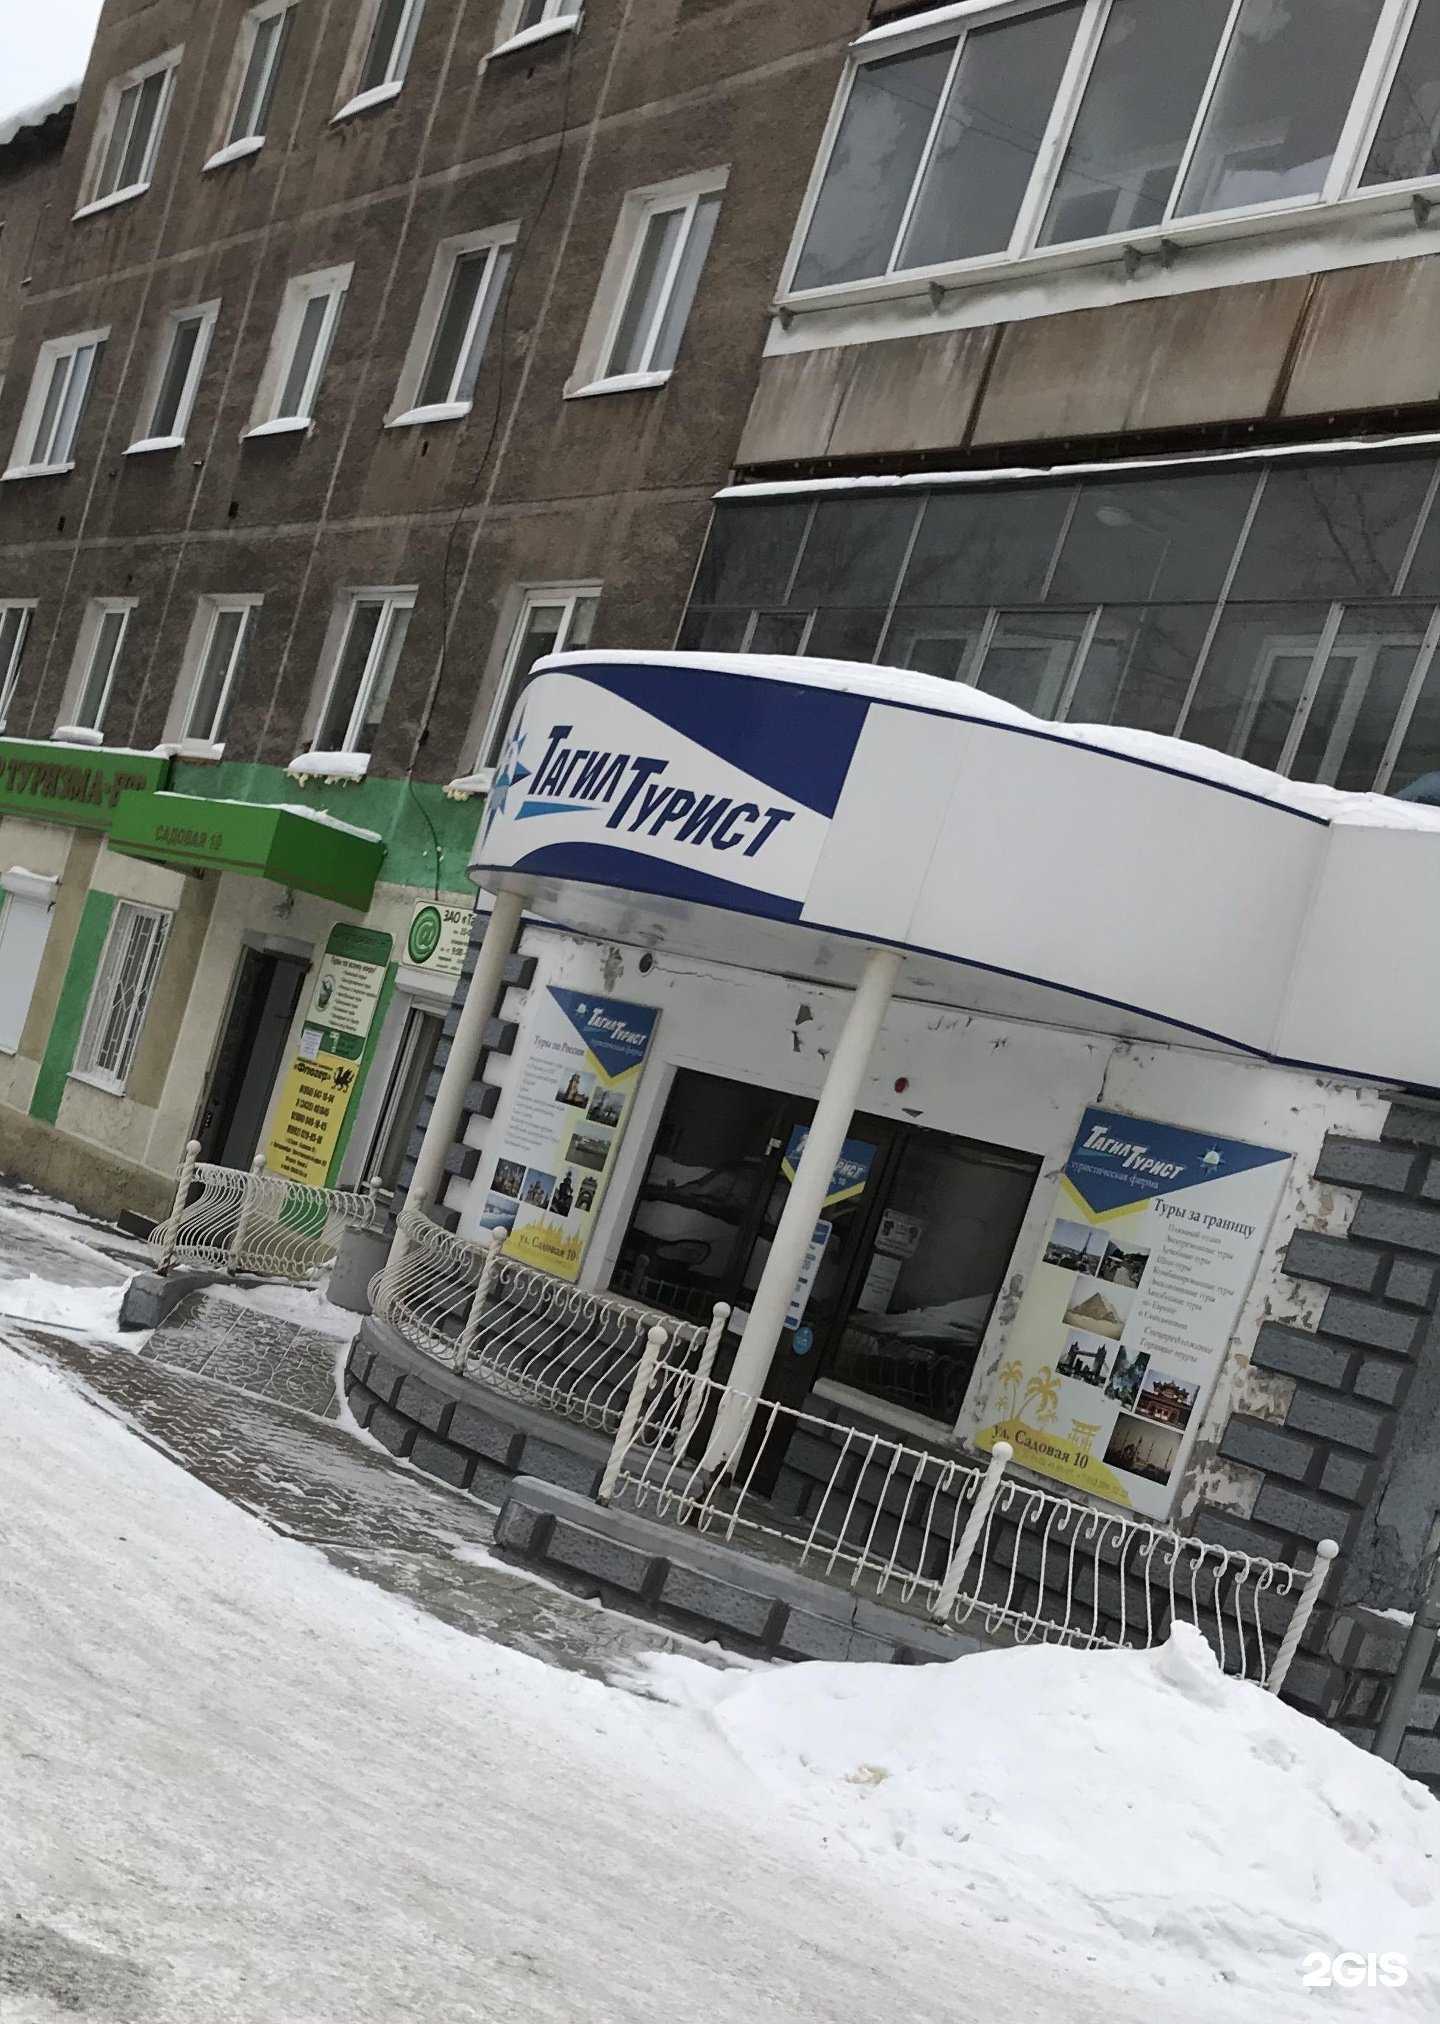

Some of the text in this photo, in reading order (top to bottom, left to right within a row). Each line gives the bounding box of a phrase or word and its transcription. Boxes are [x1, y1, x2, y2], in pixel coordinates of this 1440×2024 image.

[443, 909, 461, 924] ЗАО
[1154, 1198, 1256, 1240] Туры за границу
[1015, 1429, 1070, 1463] Садовая
[1073, 1451, 1088, 1470] 10
